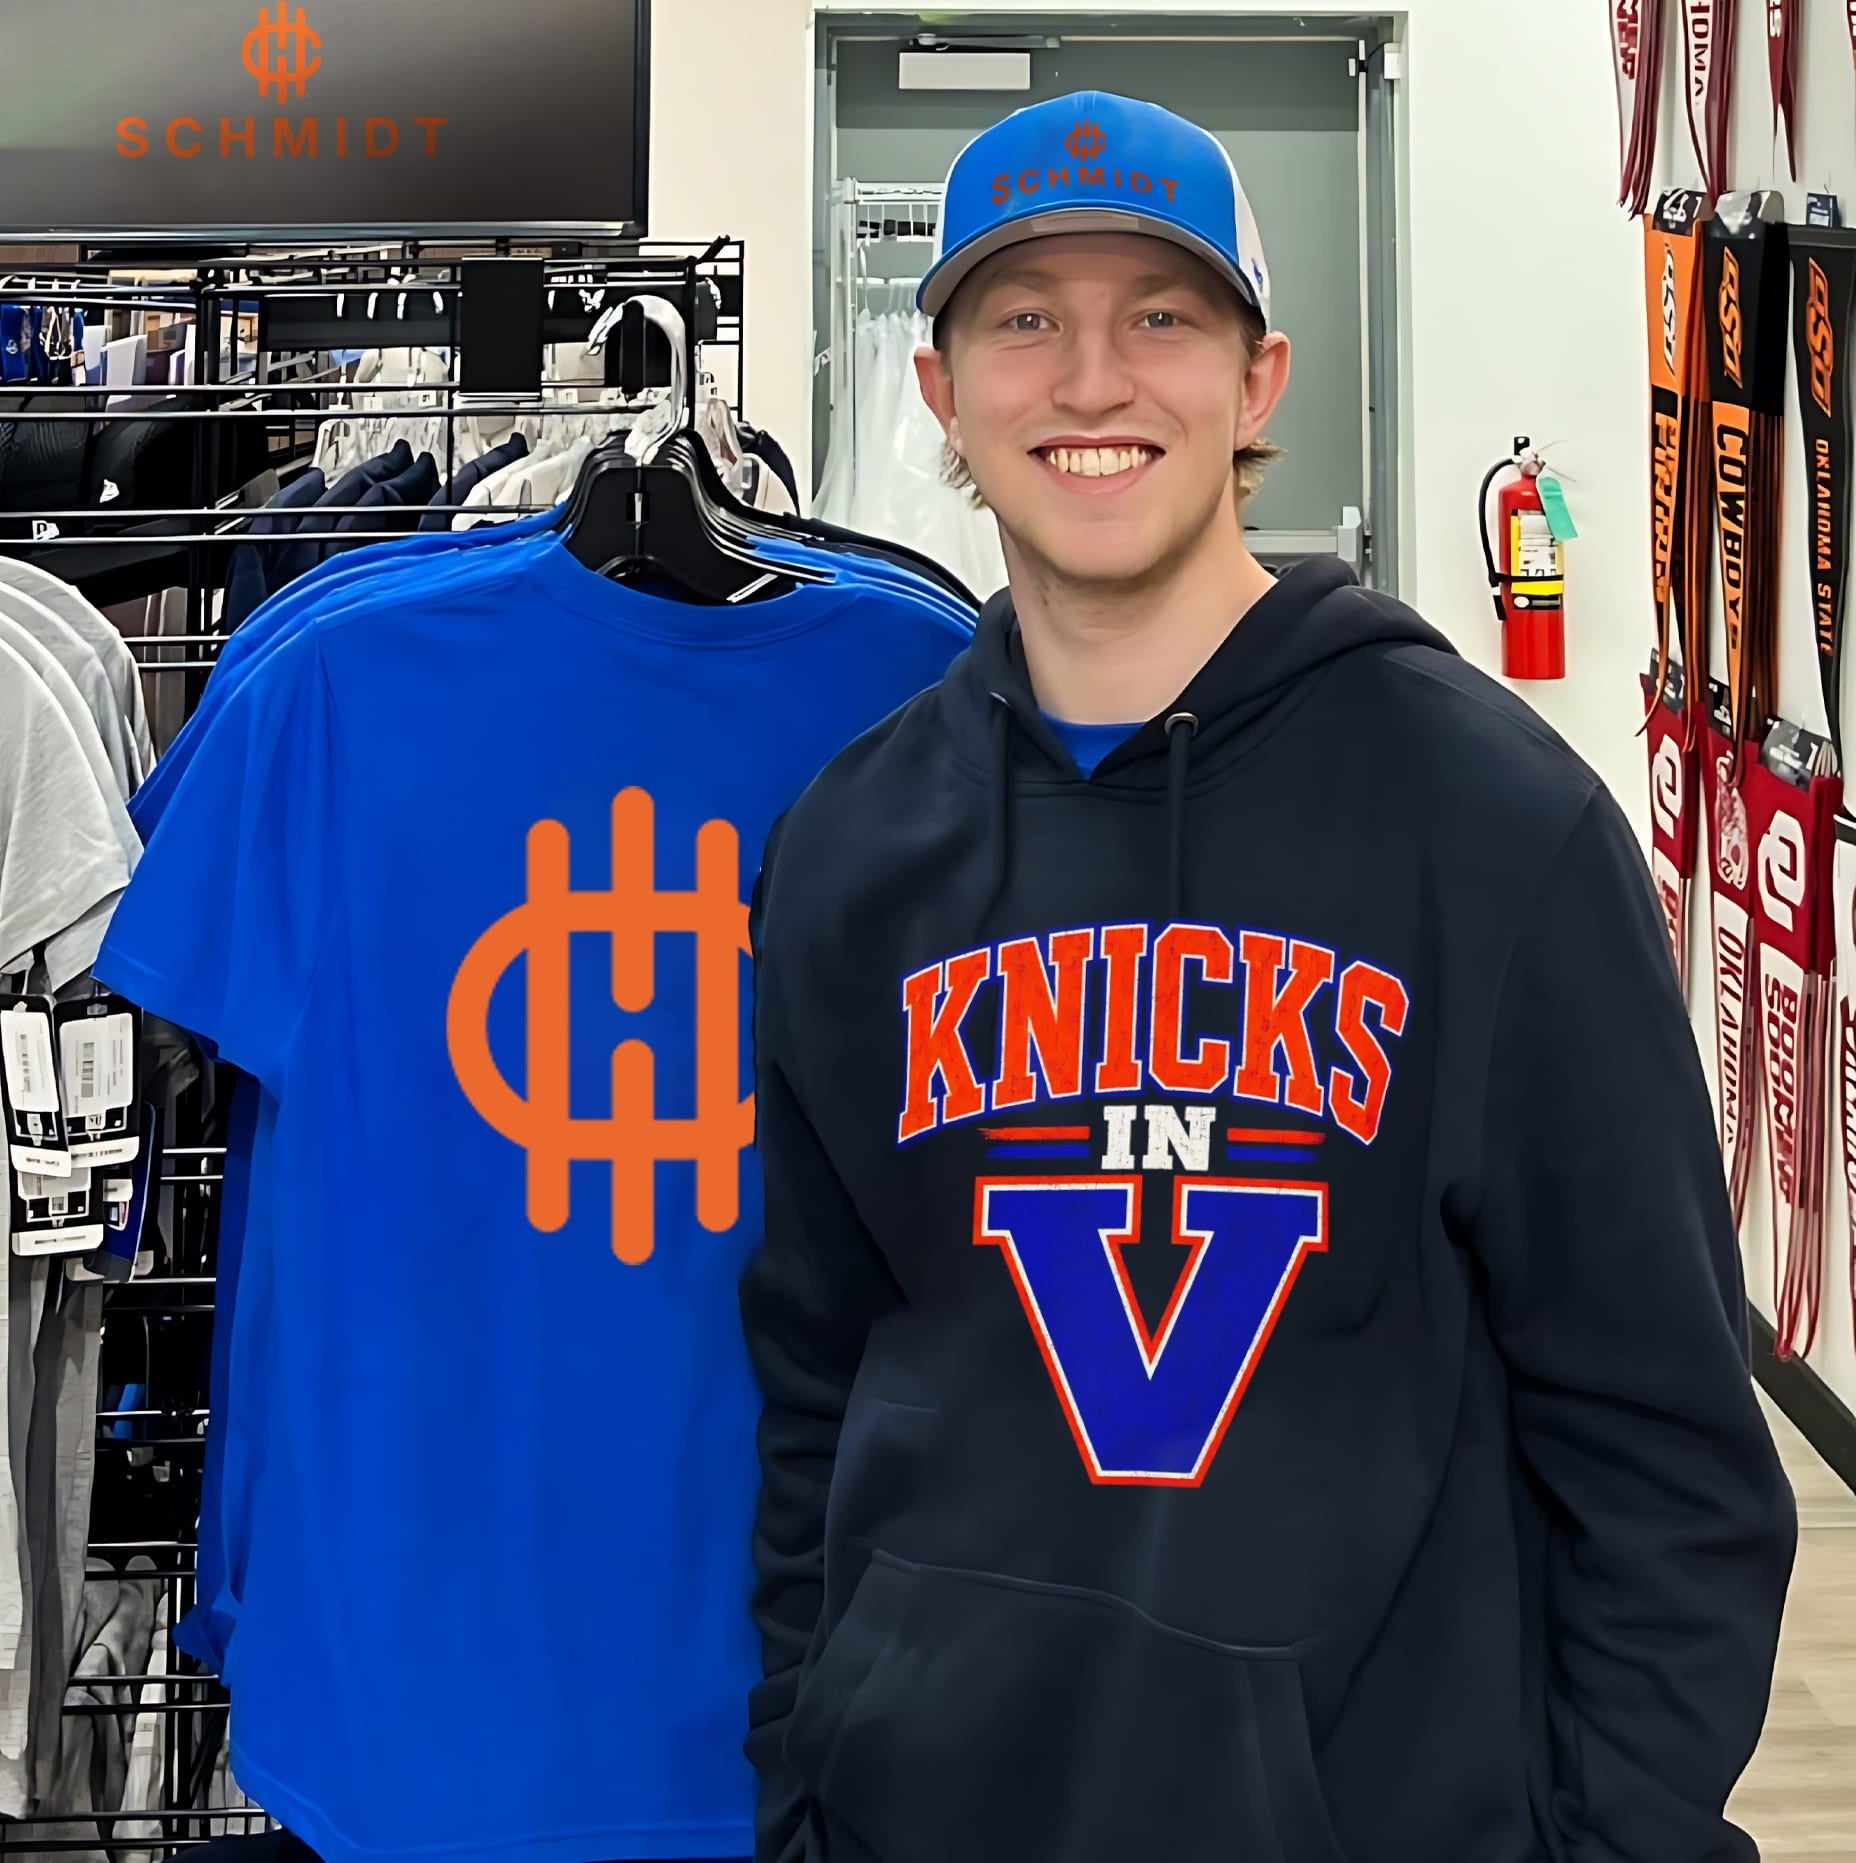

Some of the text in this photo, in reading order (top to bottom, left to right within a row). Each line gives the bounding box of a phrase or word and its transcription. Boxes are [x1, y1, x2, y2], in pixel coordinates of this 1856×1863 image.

[115, 116, 448, 159] SCHMIDT
[991, 166, 1179, 204] SCHMIDT
[1806, 257, 1833, 418] OSU
[1815, 438, 1832, 570] OKLAHOMA
[897, 922, 1410, 1147] KNICKS
[1717, 926, 1746, 1144] OKLAHOMA
[1778, 984, 1799, 1204] BOOM
[1100, 1104, 1217, 1171] IN
[972, 1174, 1329, 1488] V
